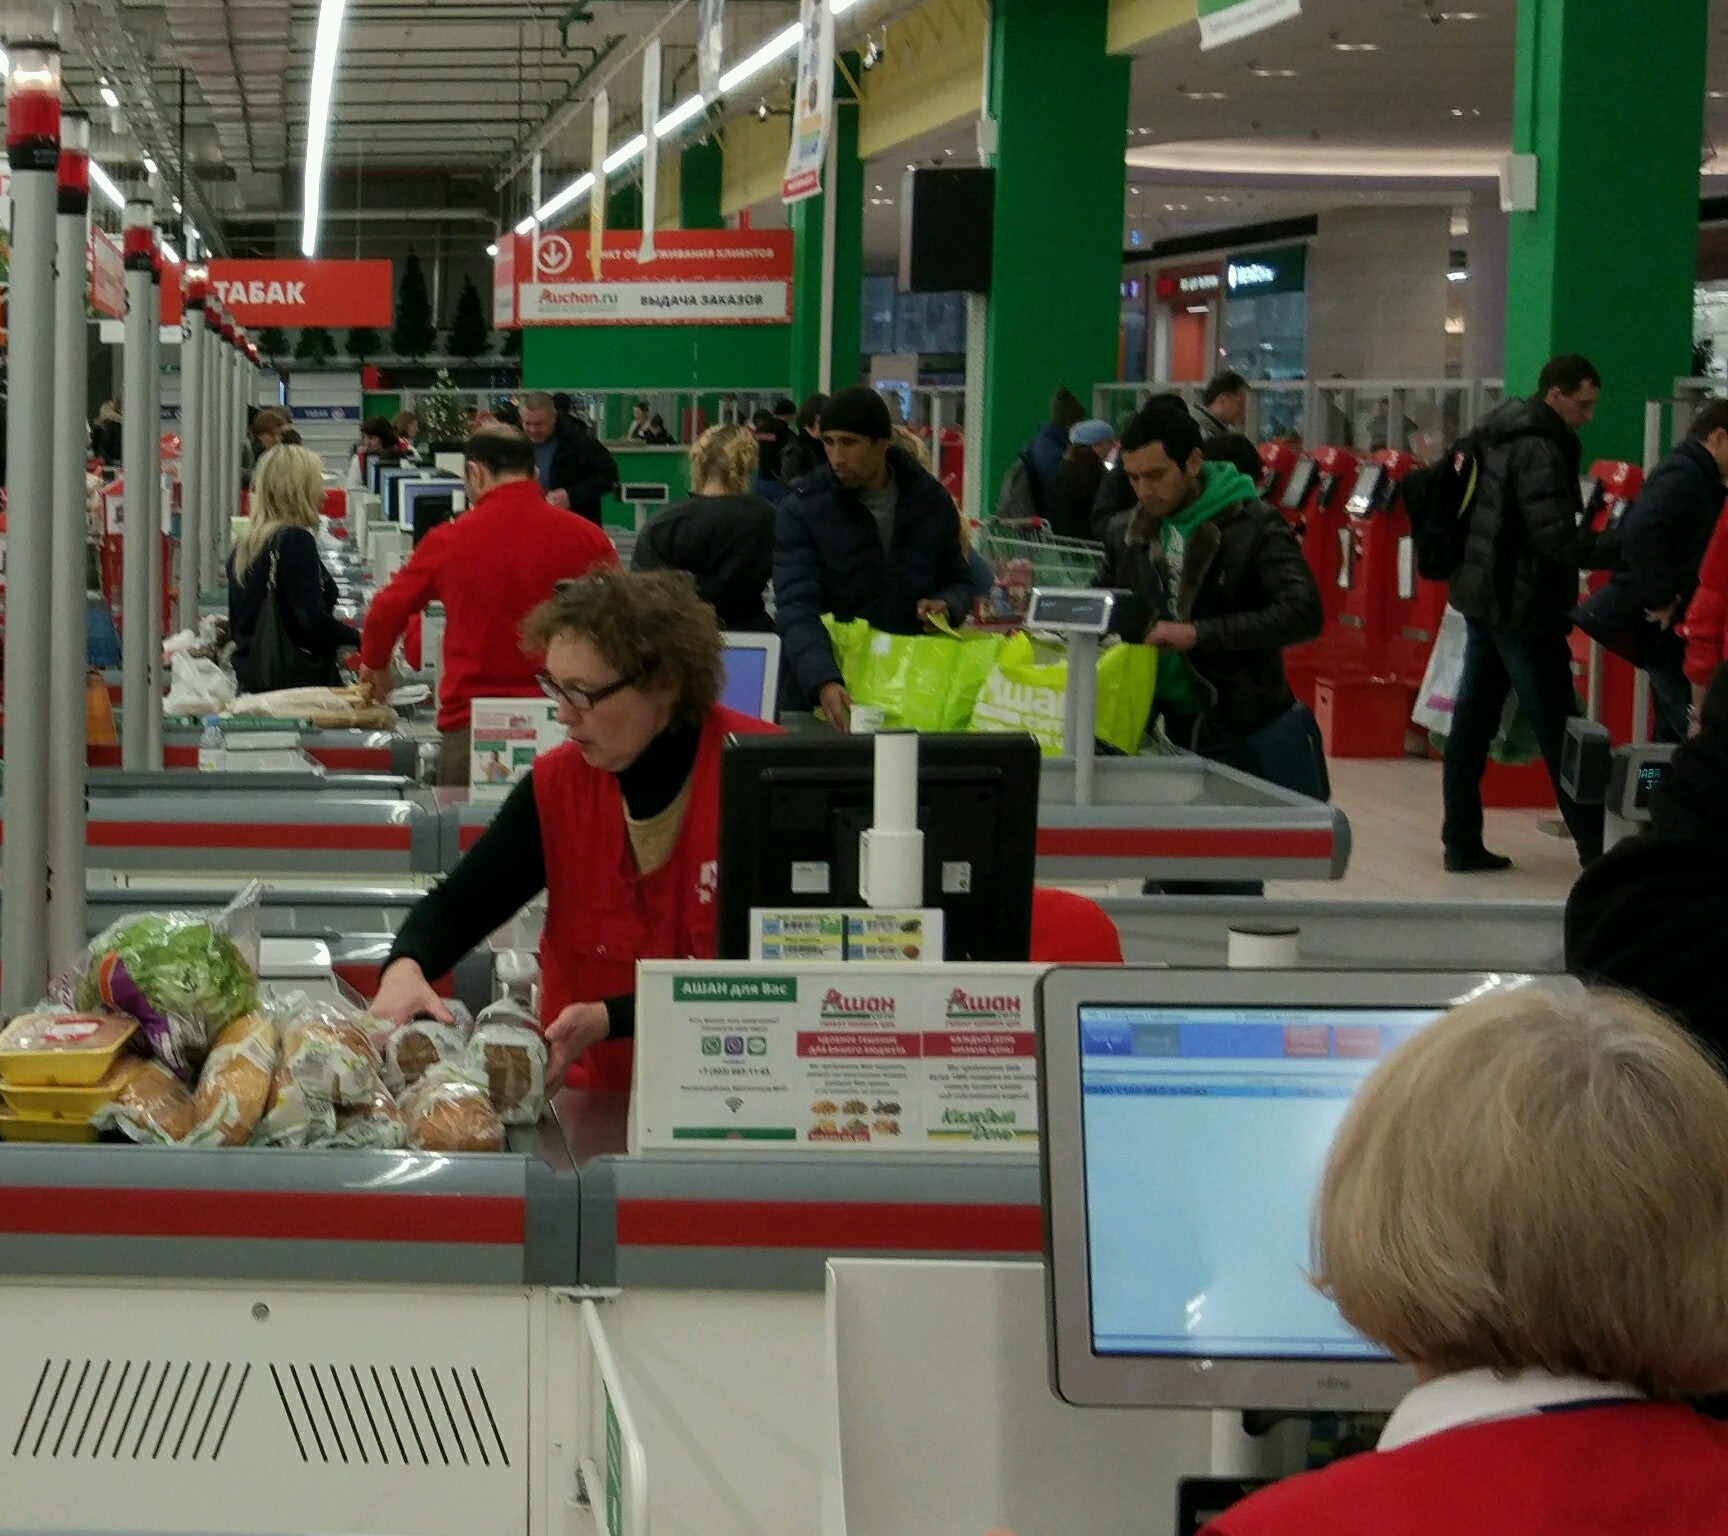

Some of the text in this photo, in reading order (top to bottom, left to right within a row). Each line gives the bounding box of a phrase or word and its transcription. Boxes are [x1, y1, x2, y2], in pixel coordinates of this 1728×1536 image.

[213, 280, 307, 305] ТАБАК
[640, 293, 764, 309] ВЫДАЧА ЗАКАЗОВ
[681, 980, 727, 996] АШАН
[822, 987, 896, 1013] Ашан
[946, 987, 1021, 1013] Ашан
